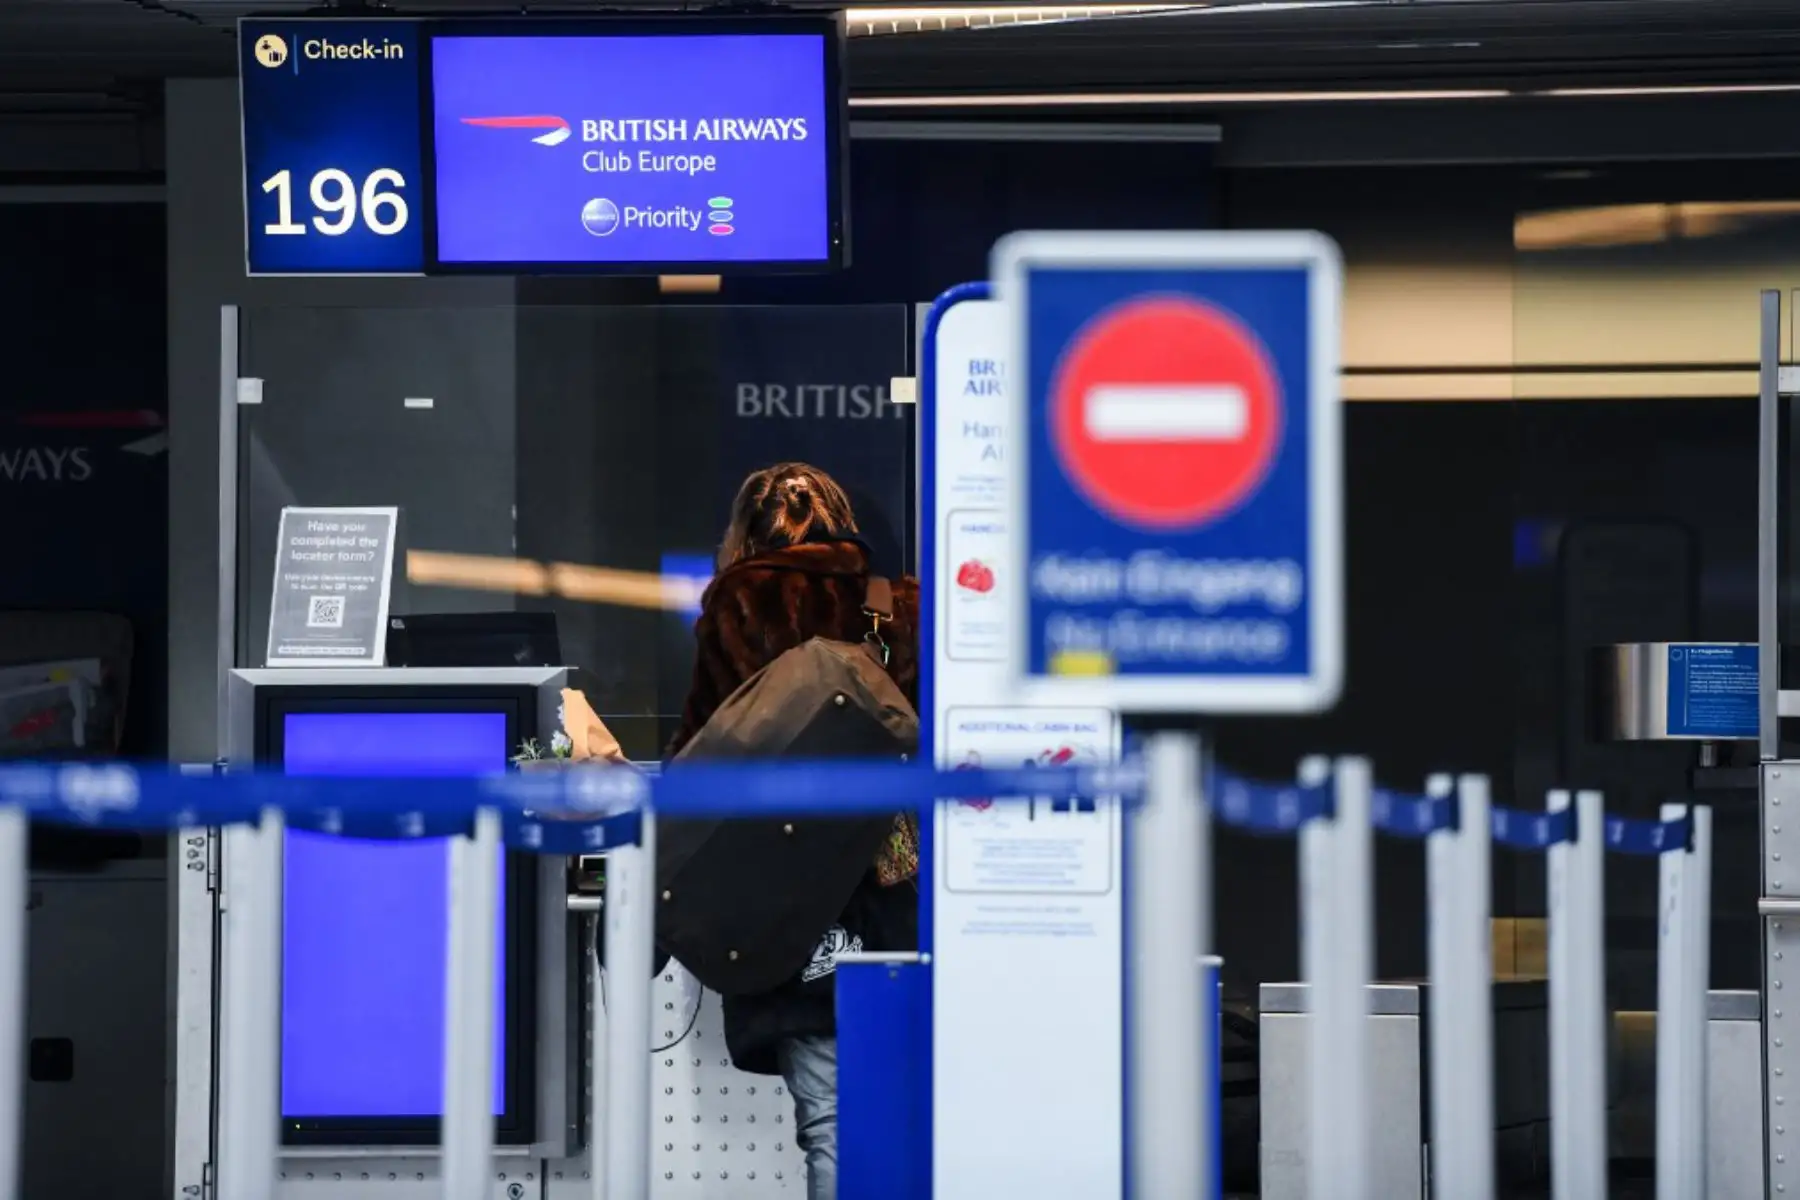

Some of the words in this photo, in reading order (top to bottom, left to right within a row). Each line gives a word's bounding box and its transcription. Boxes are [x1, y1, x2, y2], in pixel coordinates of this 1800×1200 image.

[303, 38, 404, 61] Check-in
[582, 119, 688, 142] BRITISH
[693, 117, 808, 141] AIRWAYS
[582, 150, 632, 173] Club
[638, 151, 717, 177] Europe
[260, 167, 409, 237] 196
[623, 206, 702, 232] Priority
[735, 382, 904, 419] BRITISH
[307, 520, 339, 532] Have
[342, 522, 366, 534] you
[290, 535, 356, 549] completed
[358, 536, 379, 548] the
[291, 549, 335, 562] locator
[337, 549, 375, 563] form?
